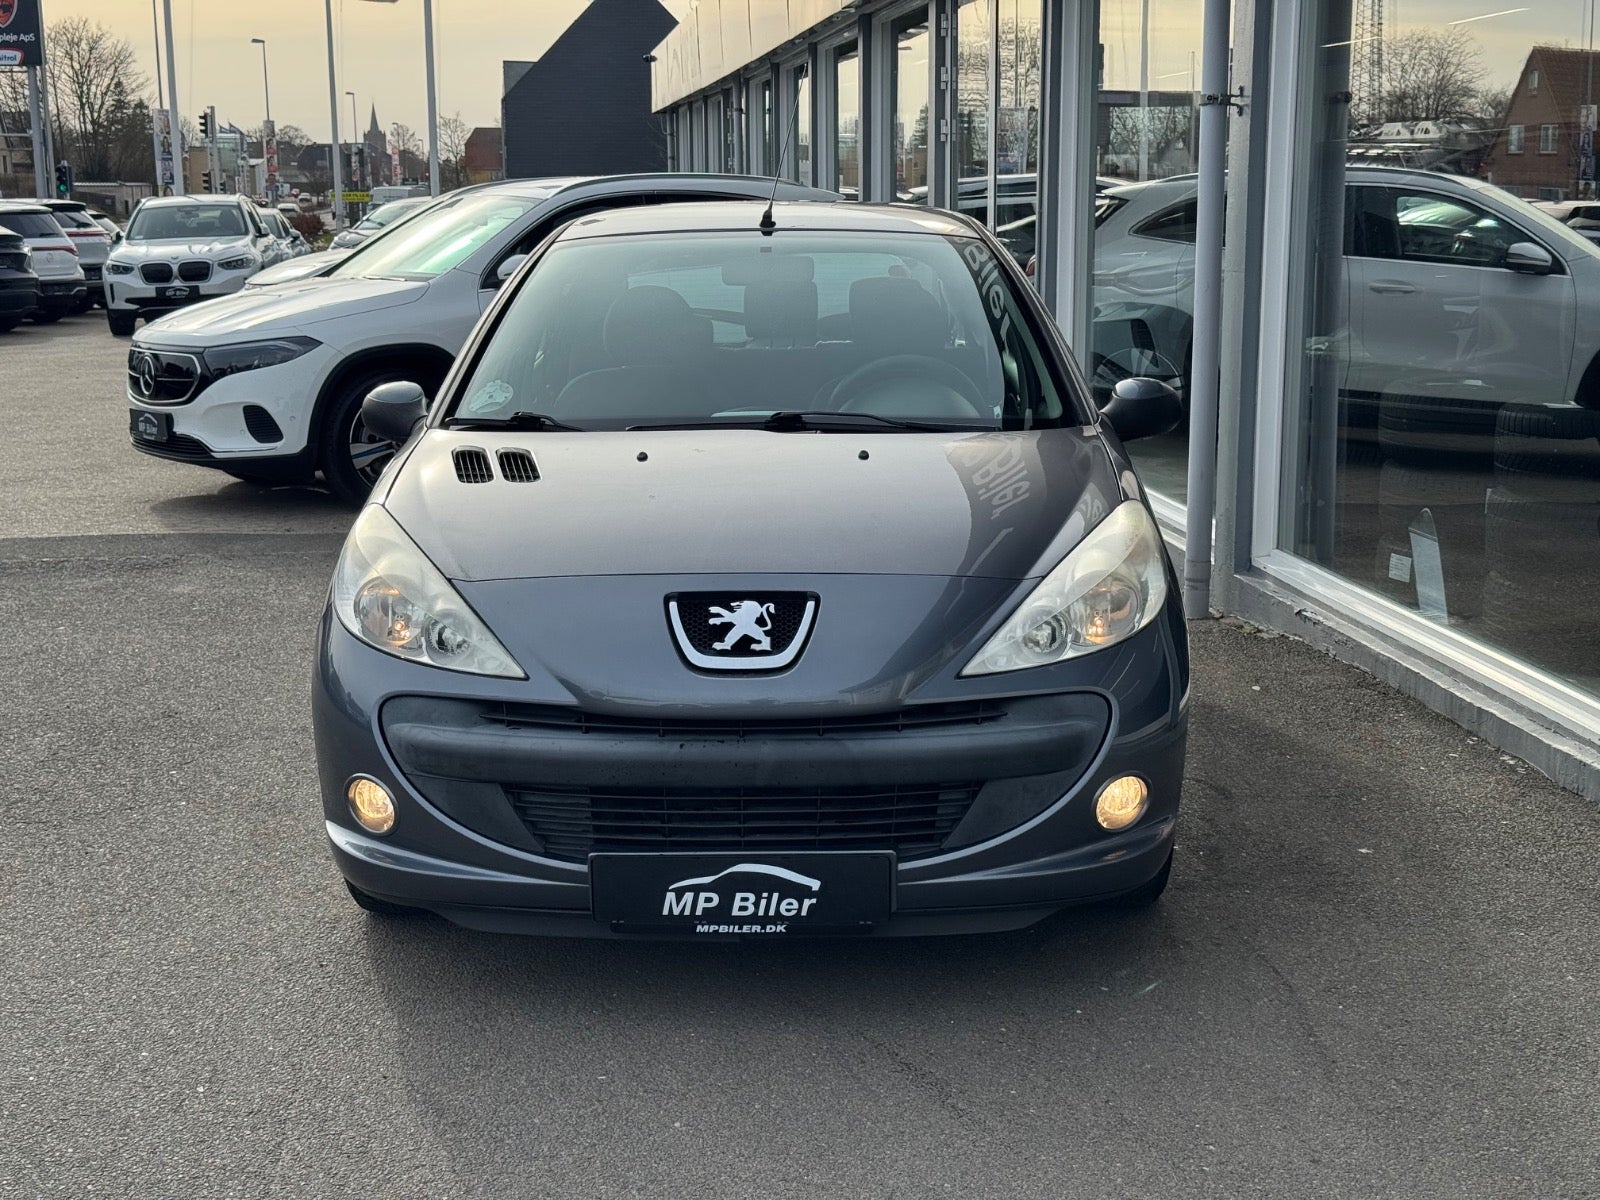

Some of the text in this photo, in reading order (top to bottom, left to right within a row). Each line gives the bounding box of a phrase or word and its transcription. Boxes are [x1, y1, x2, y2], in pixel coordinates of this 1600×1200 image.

[19, 33, 35, 43] ApS
[662, 891, 817, 917] MP Biler
[696, 925, 787, 933] MPBILER.DK
